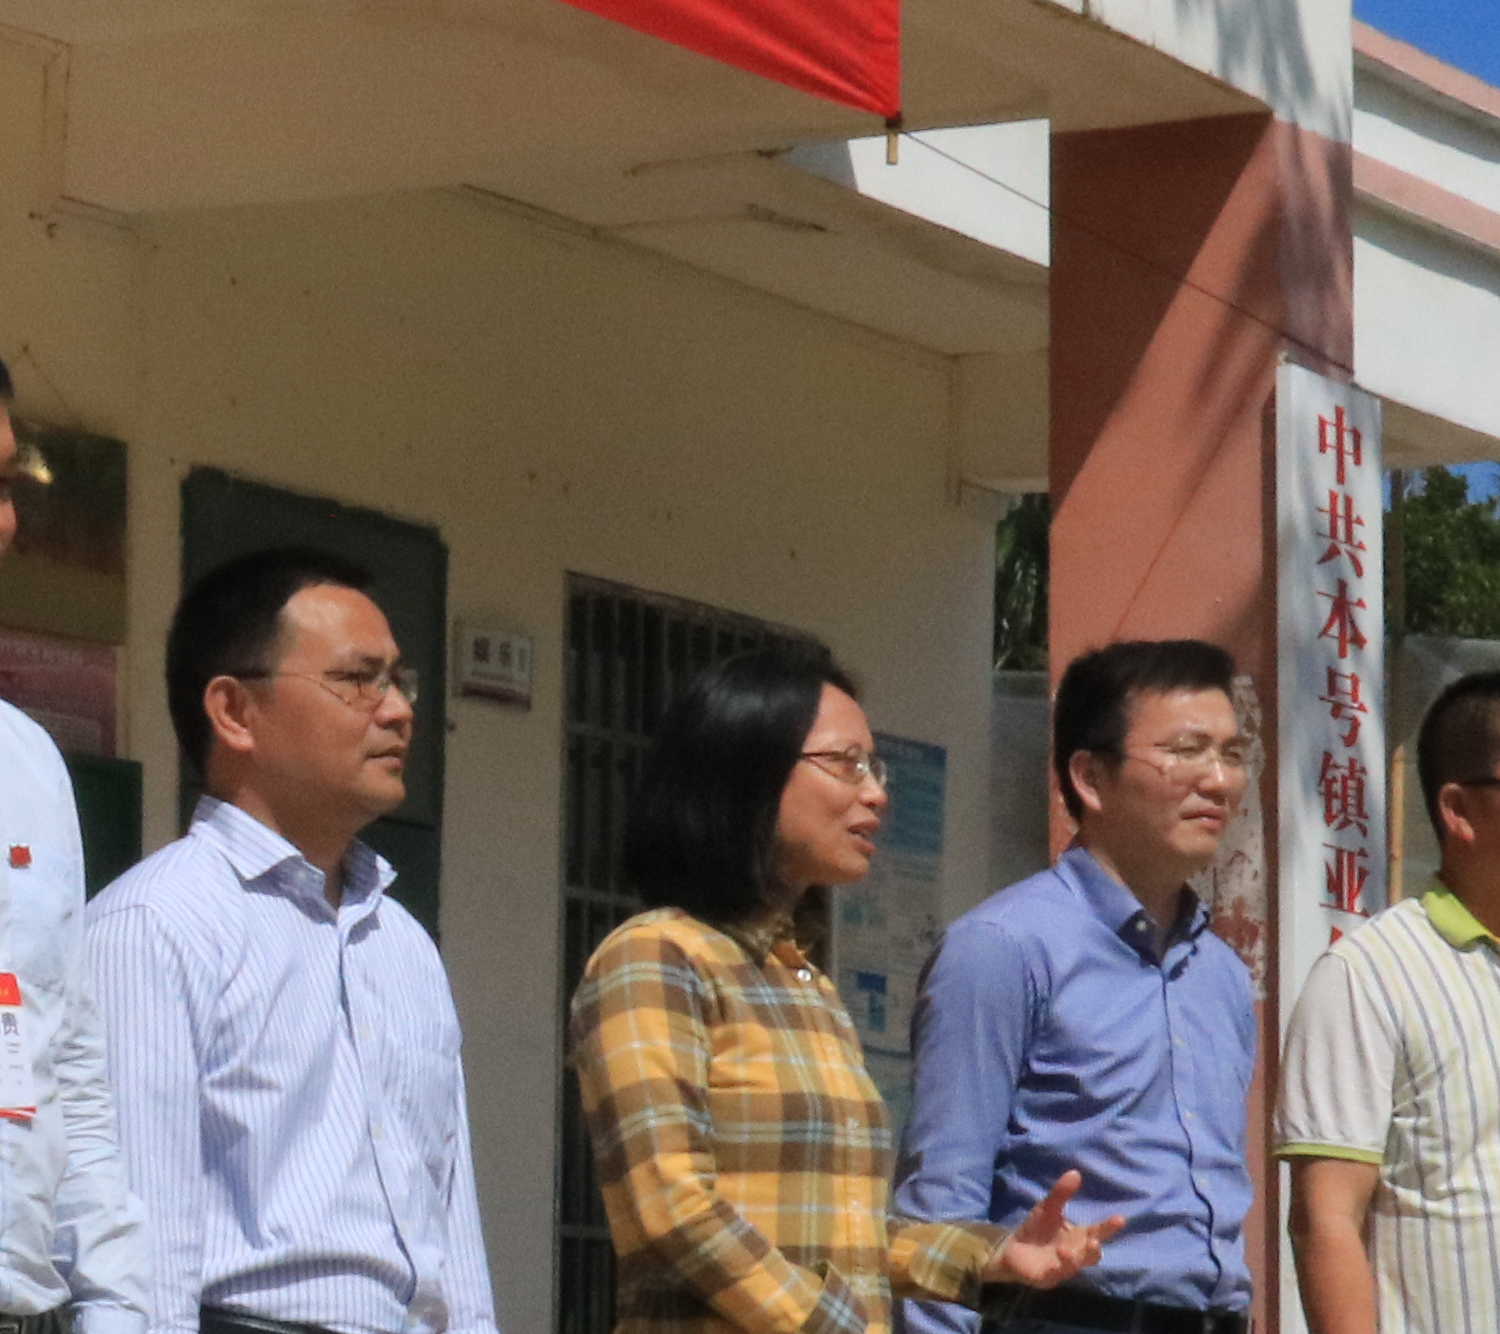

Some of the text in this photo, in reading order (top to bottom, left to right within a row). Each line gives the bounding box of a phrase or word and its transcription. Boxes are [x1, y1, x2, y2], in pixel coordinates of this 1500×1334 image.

[1315, 404, 1371, 947] 中共本号镇亚
